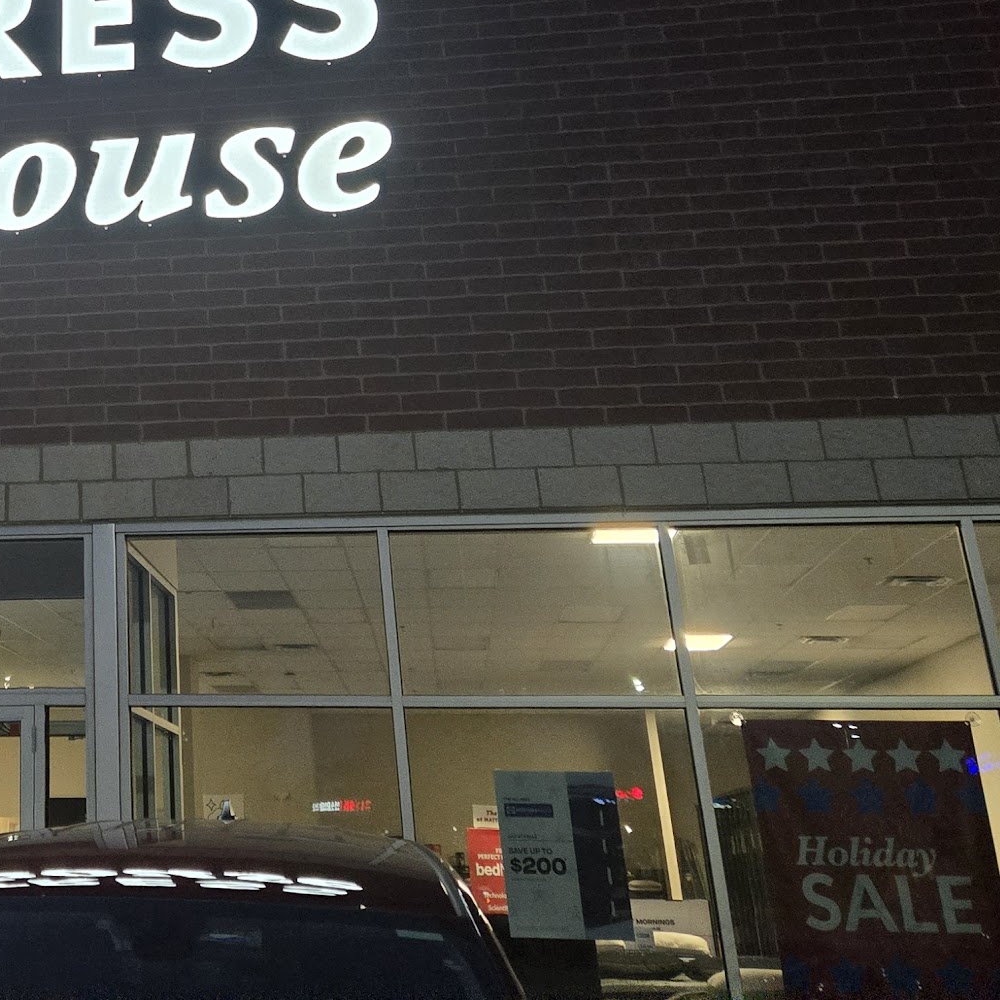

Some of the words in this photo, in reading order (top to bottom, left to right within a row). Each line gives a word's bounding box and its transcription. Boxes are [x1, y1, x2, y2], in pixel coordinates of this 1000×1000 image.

[508, 847, 528, 855] SAVE
[796, 835, 938, 877] Holiday
[510, 857, 567, 876] $200
[801, 872, 983, 935] SALE
